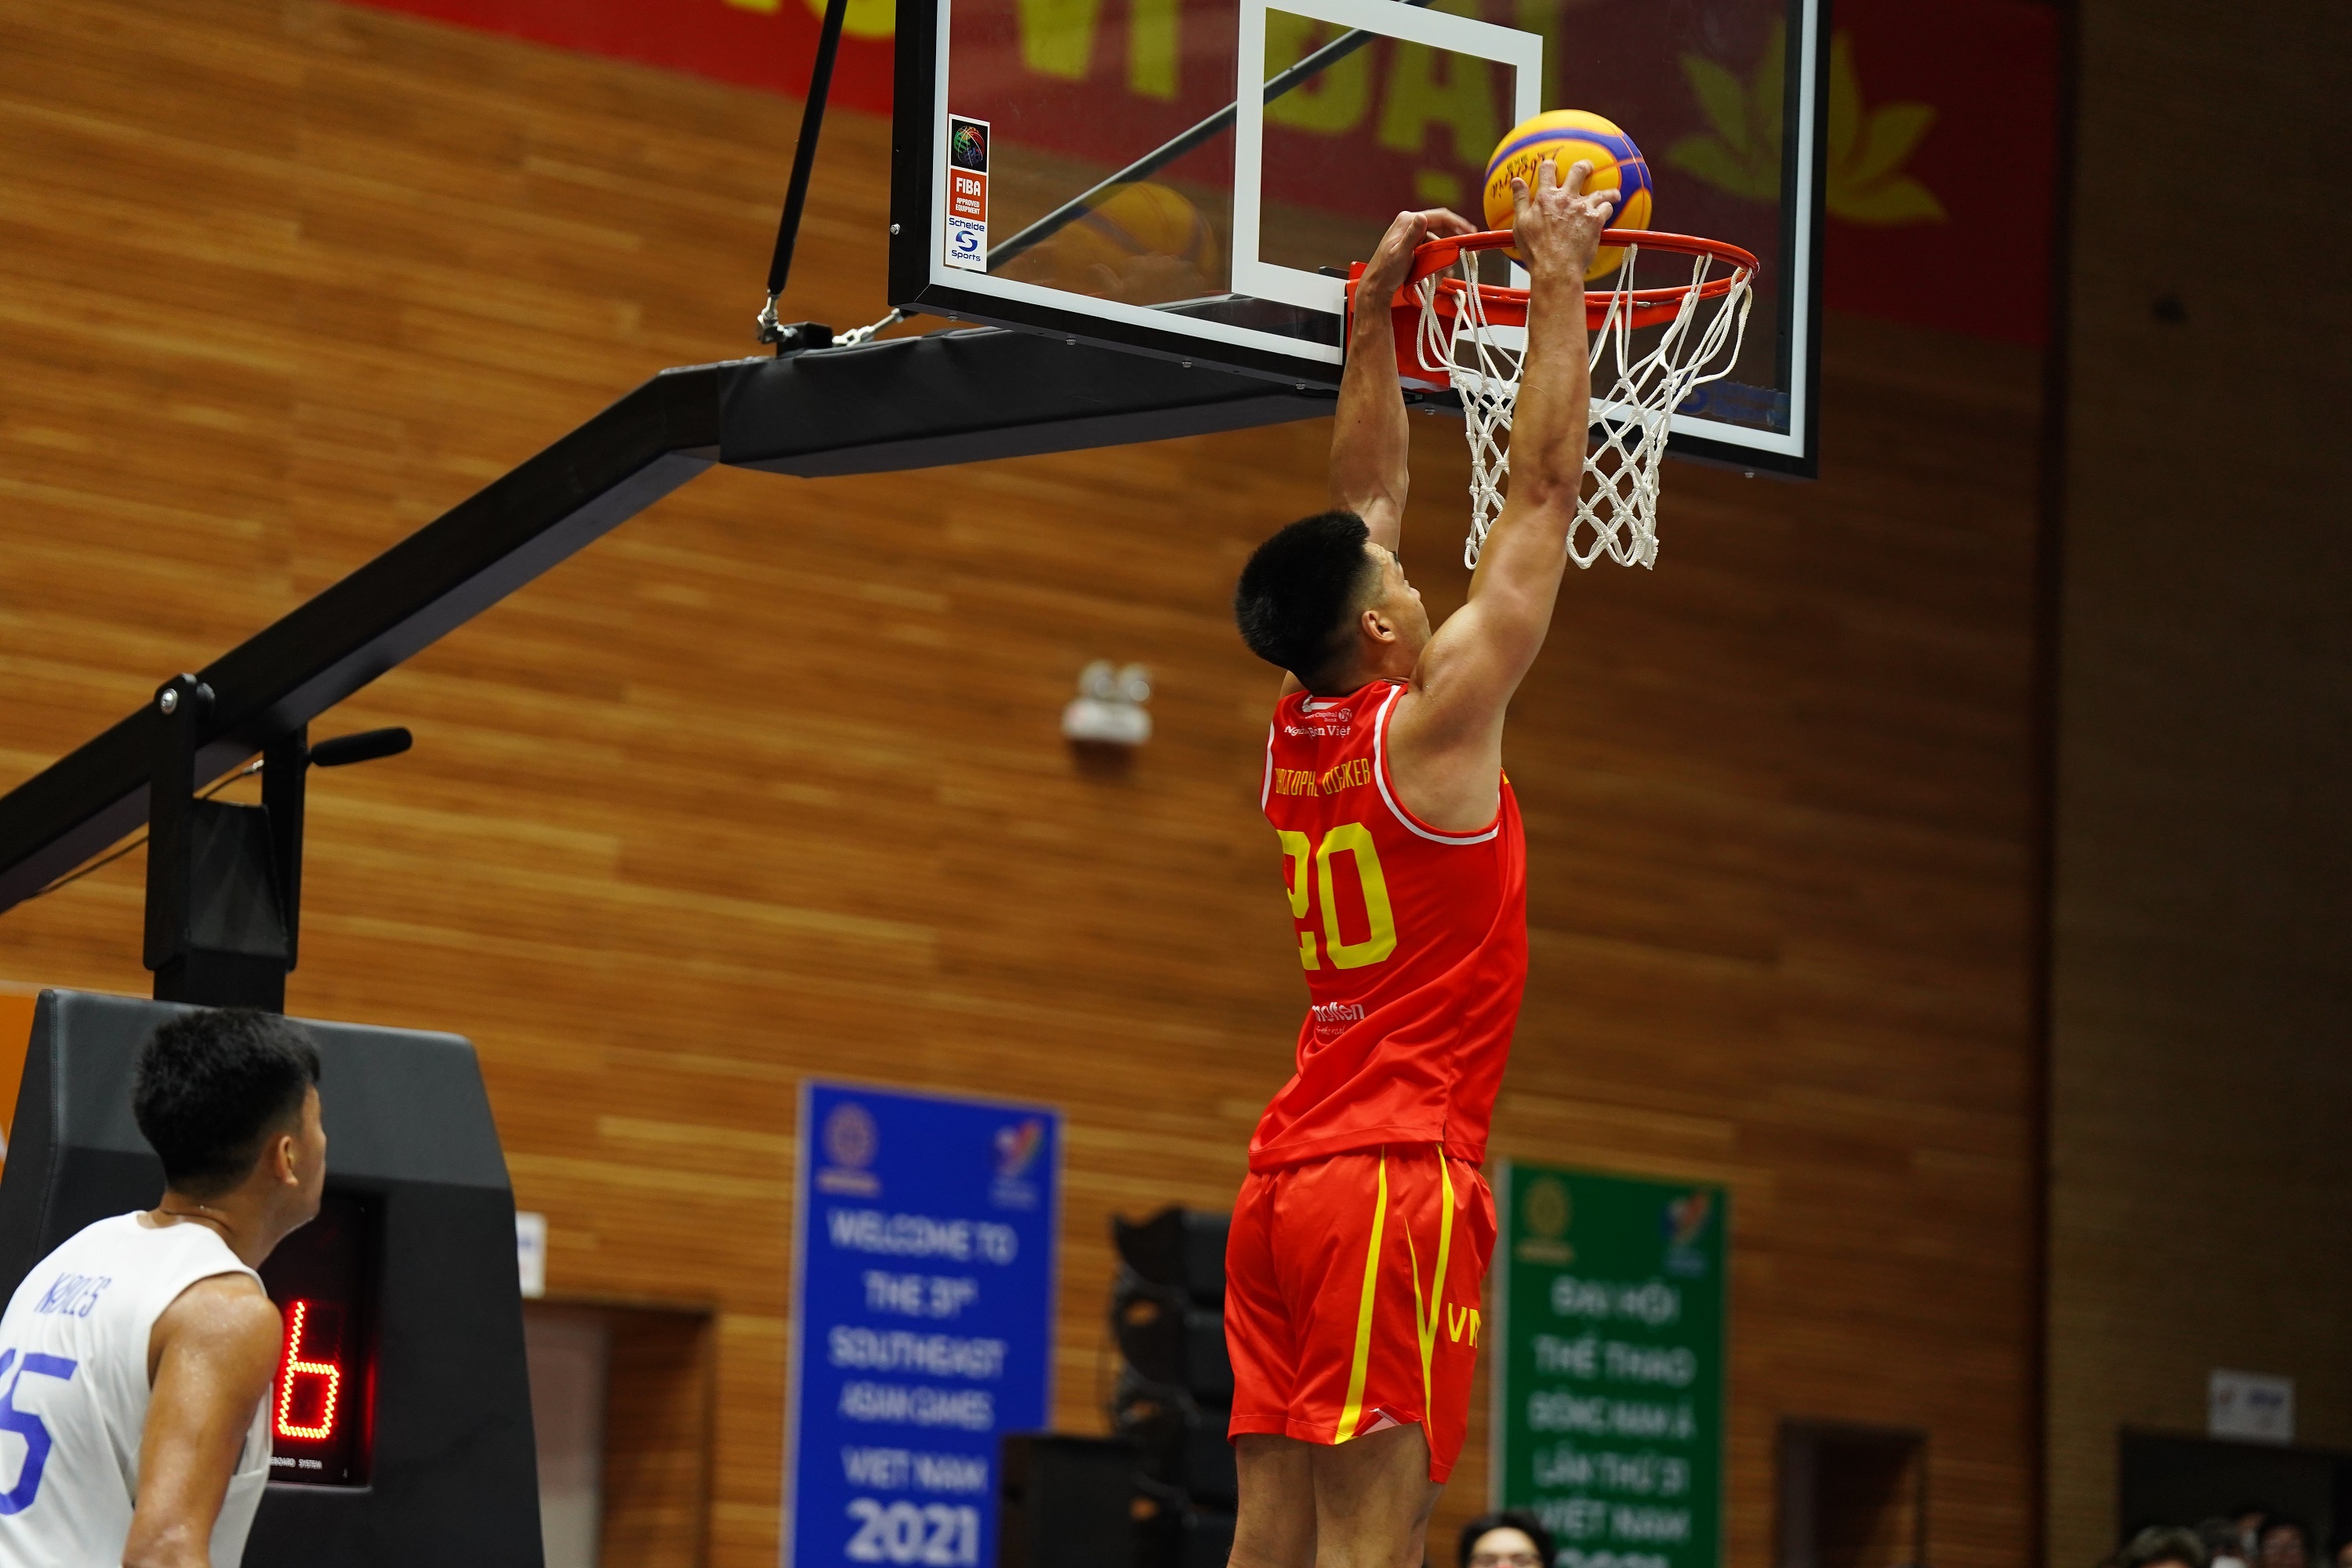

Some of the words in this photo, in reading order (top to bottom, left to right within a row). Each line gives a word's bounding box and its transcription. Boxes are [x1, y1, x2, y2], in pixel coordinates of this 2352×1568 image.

[956, 176, 981, 196] FIBA
[956, 197, 980, 208] APPROVED
[949, 217, 985, 232] Schelde
[955, 204, 981, 215] EQUIPMENT
[951, 249, 981, 262] Sports
[1327, 724, 1351, 738] Việt
[1277, 822, 1398, 971] 20
[828, 1208, 971, 1262] WELCOME
[976, 1221, 1018, 1265] TO
[864, 1269, 921, 1316] THE
[278, 1301, 339, 1439] 6
[828, 1325, 1008, 1377] SOUTHEAST
[910, 1386, 994, 1432] GAMES
[0, 1348, 78, 1515] 5
[299, 1459, 323, 1470] SYSTEM
[912, 1452, 989, 1494] NAM
[844, 1497, 979, 1566] 2021
